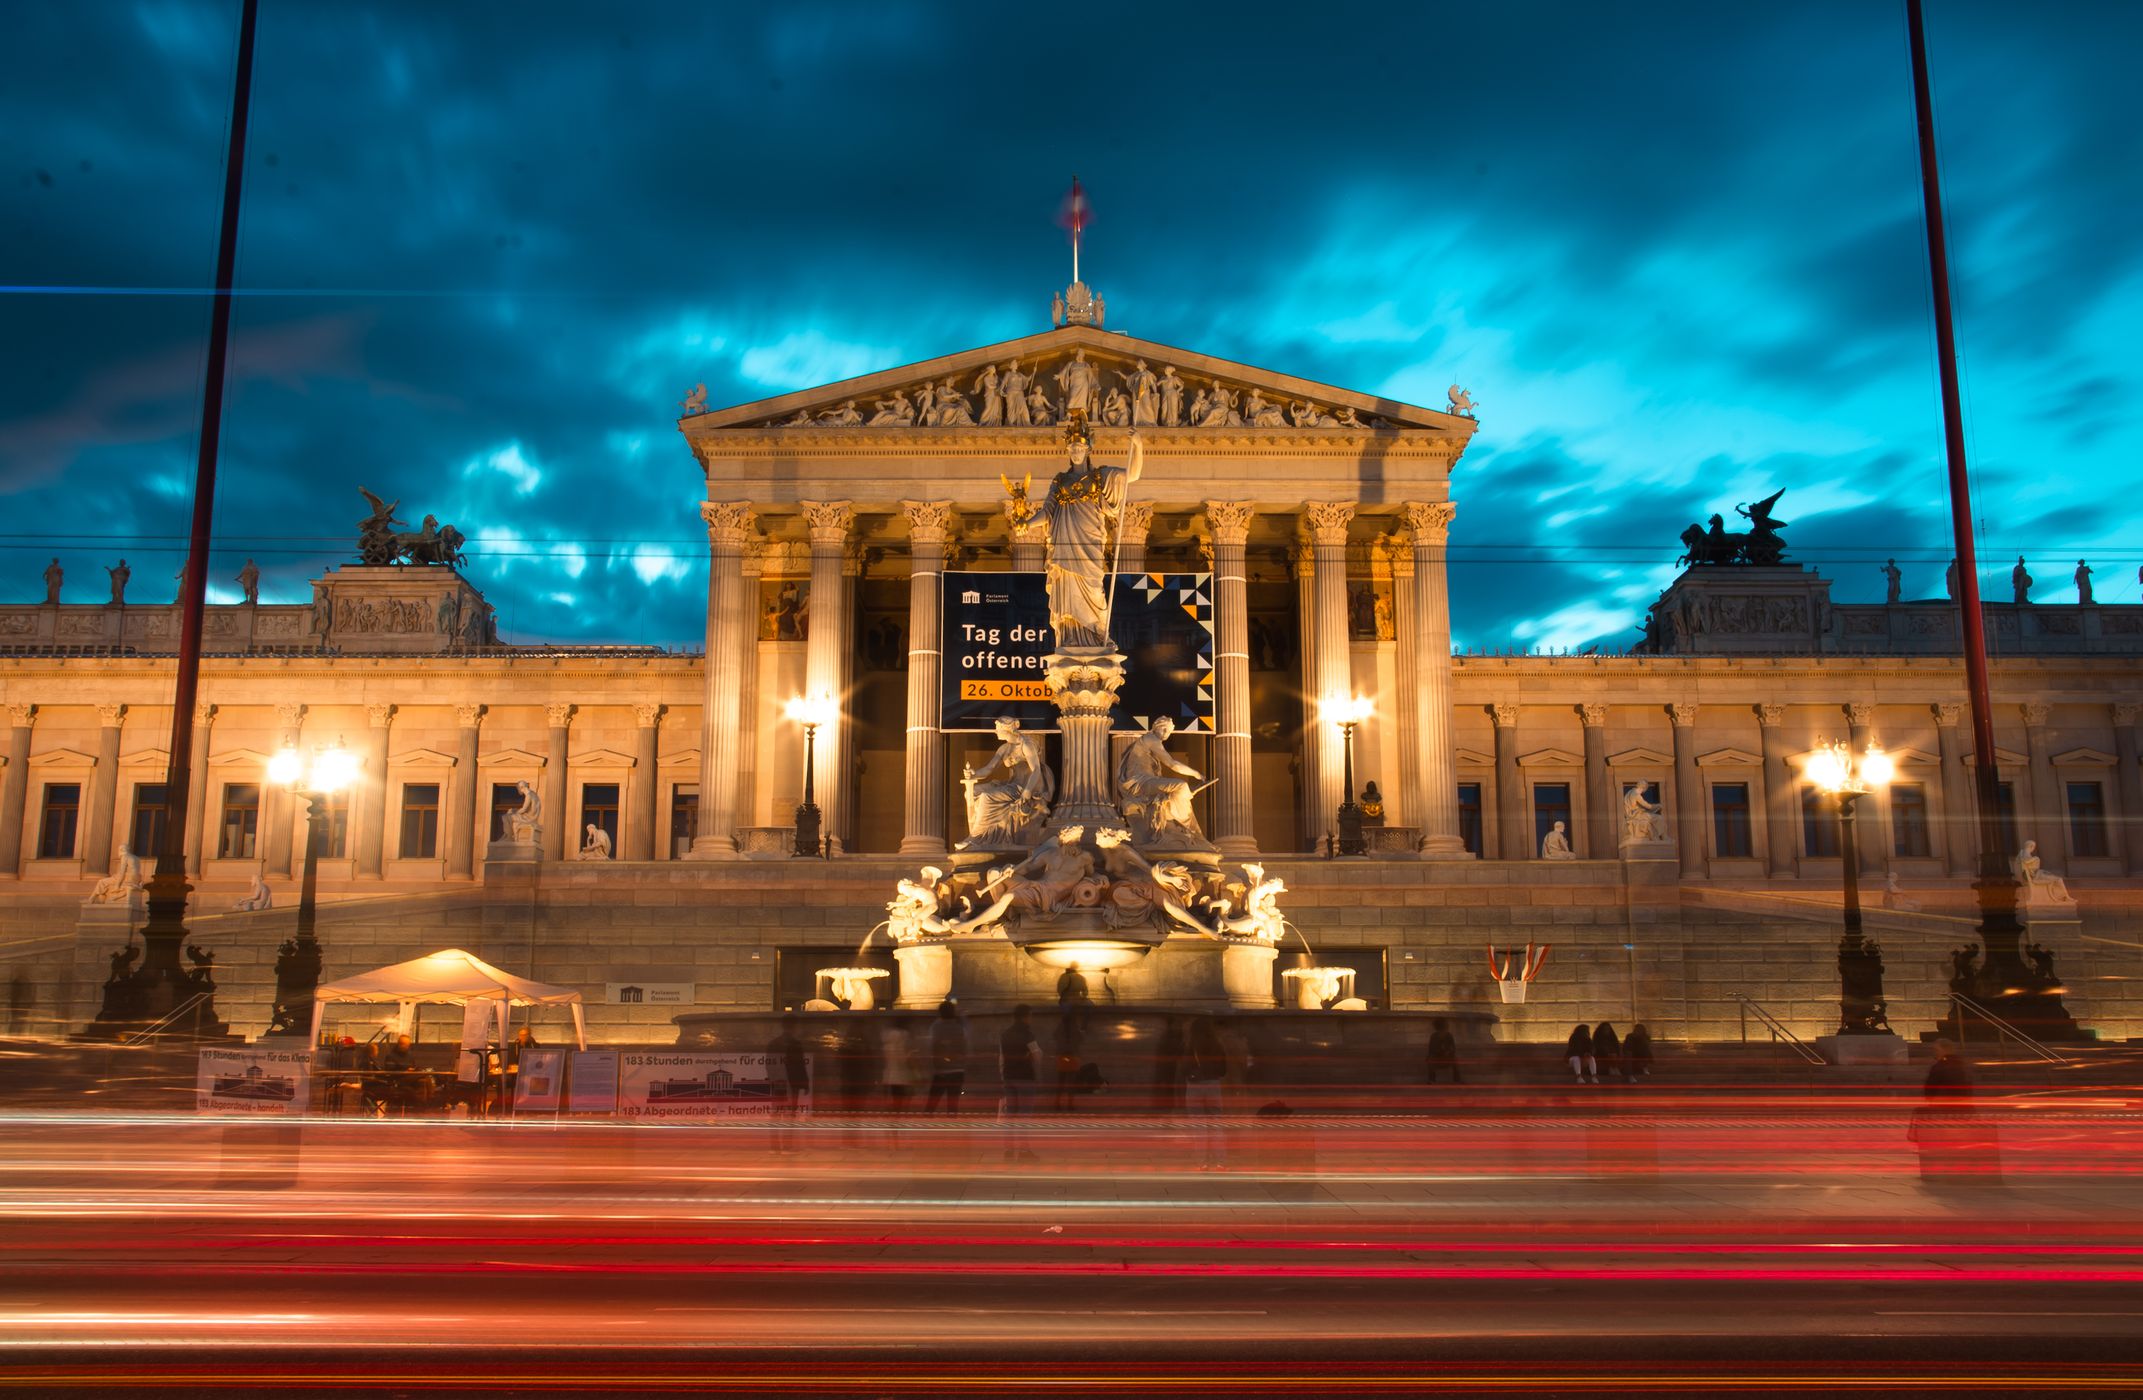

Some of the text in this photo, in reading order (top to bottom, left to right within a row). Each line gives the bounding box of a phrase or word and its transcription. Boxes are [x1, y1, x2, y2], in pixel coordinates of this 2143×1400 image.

[962, 624, 1047, 645] Tag der
[968, 684, 1053, 697] 26. Oktob
[267, 1052, 277, 1061] für
[279, 1053, 290, 1062] das
[625, 1056, 644, 1065] 183
[646, 1056, 693, 1065] Stunden
[740, 1056, 756, 1065] für
[758, 1056, 777, 1065] das
[623, 1107, 641, 1115] 183
[644, 1106, 718, 1117] Abgeordnete
[728, 1105, 770, 1115] handelt
